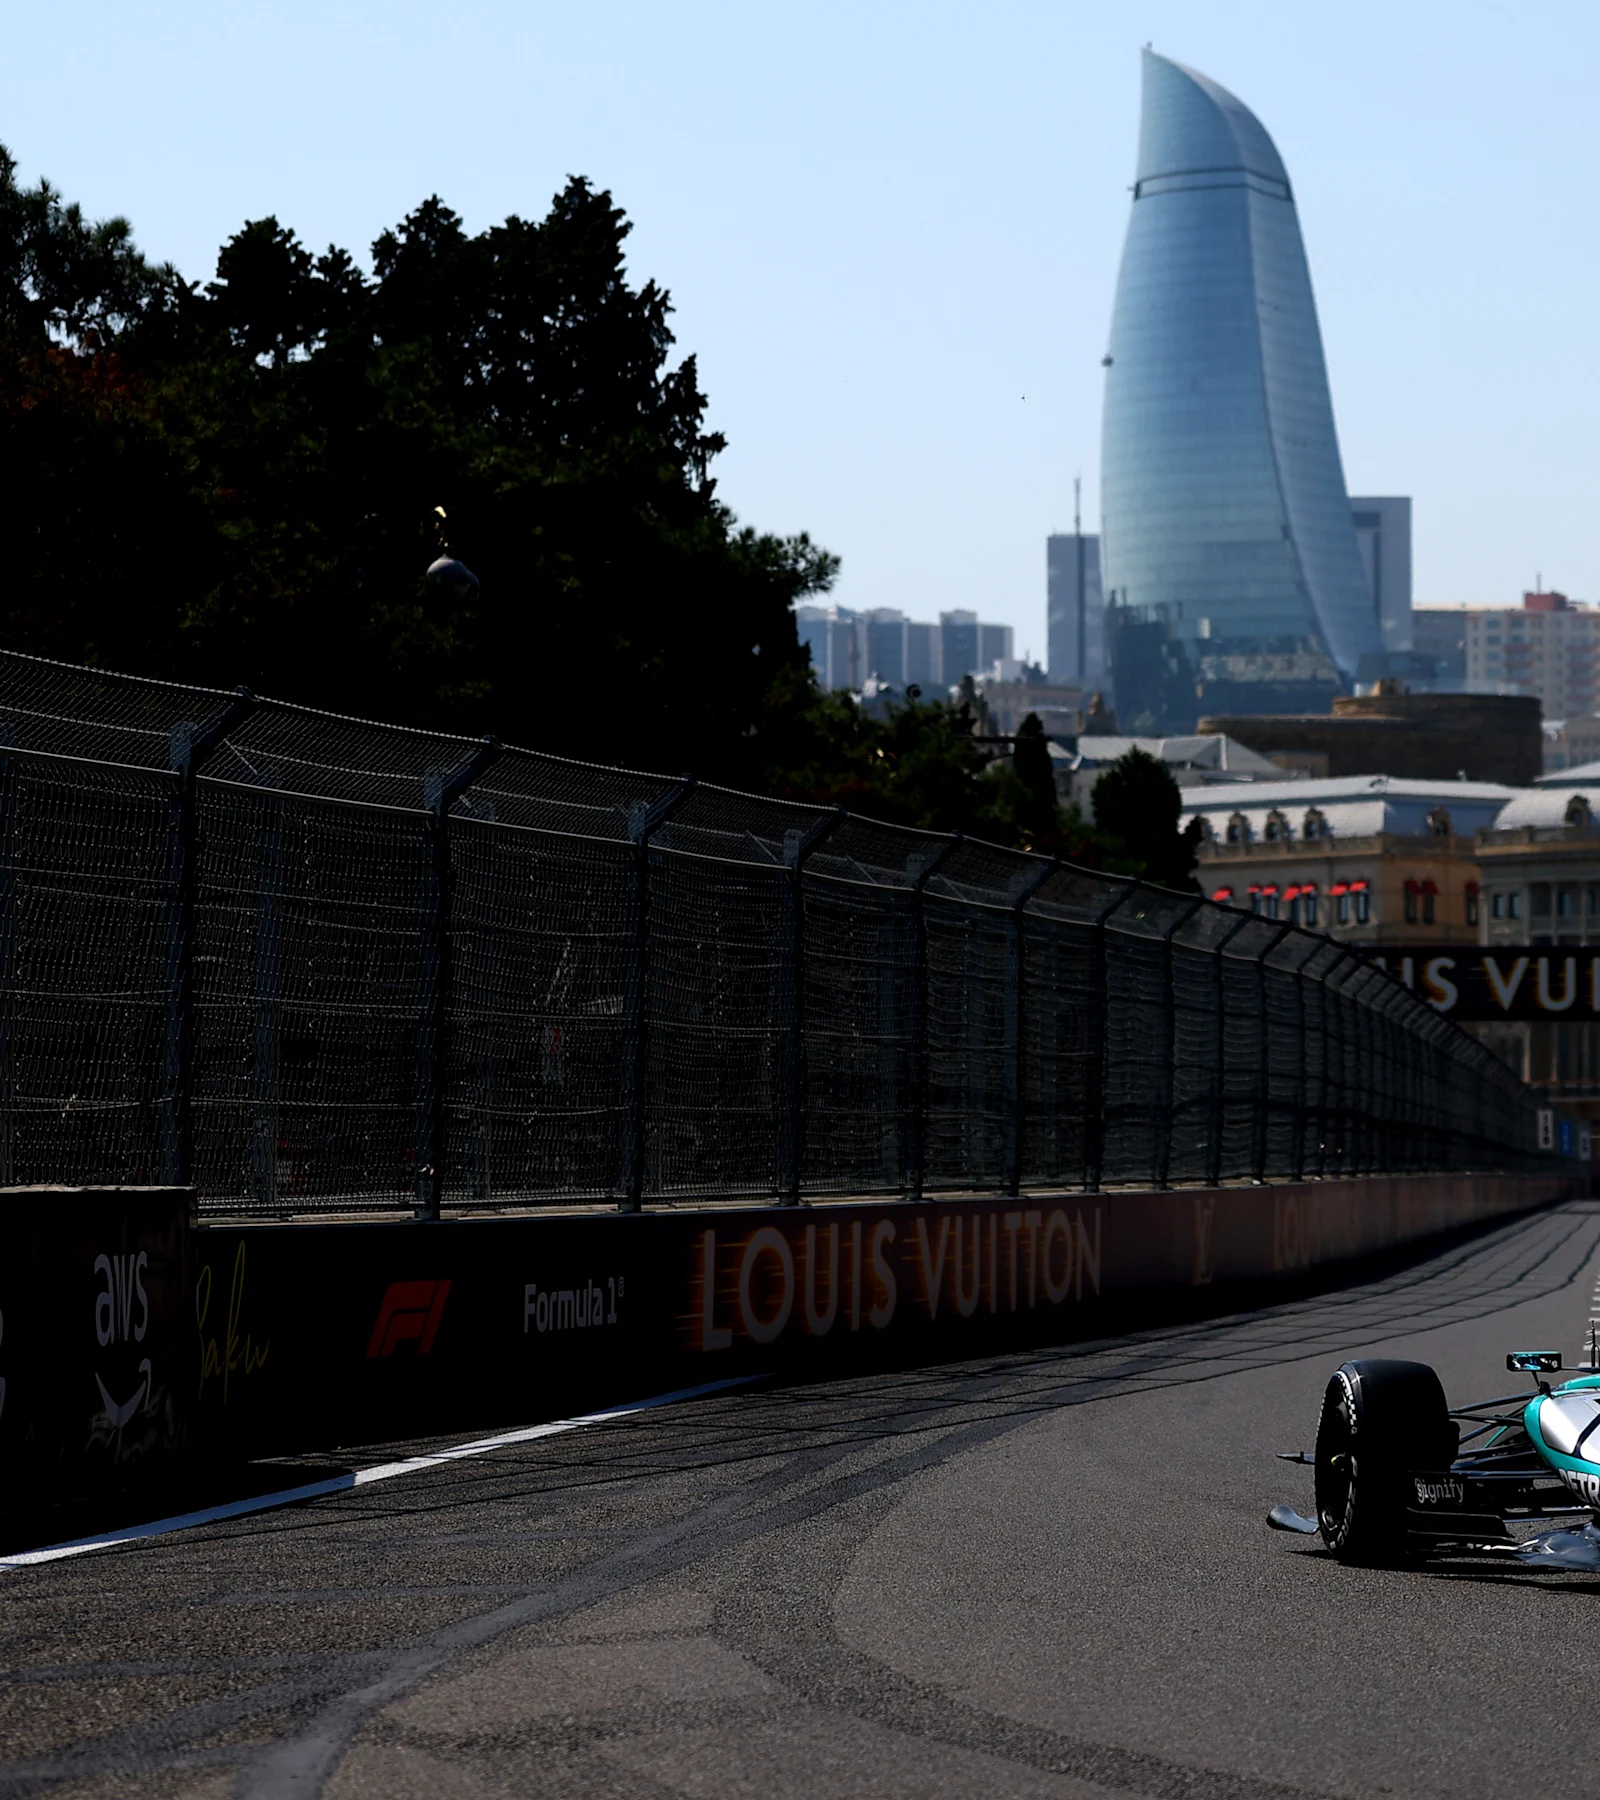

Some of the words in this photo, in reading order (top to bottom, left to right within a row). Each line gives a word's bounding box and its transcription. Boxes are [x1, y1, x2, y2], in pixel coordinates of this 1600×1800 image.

[94, 1250, 149, 1347] aws
[524, 1278, 604, 1333] Formula
[700, 1218, 897, 1352] LOUIS
[915, 1207, 1101, 1321] VUITTON
